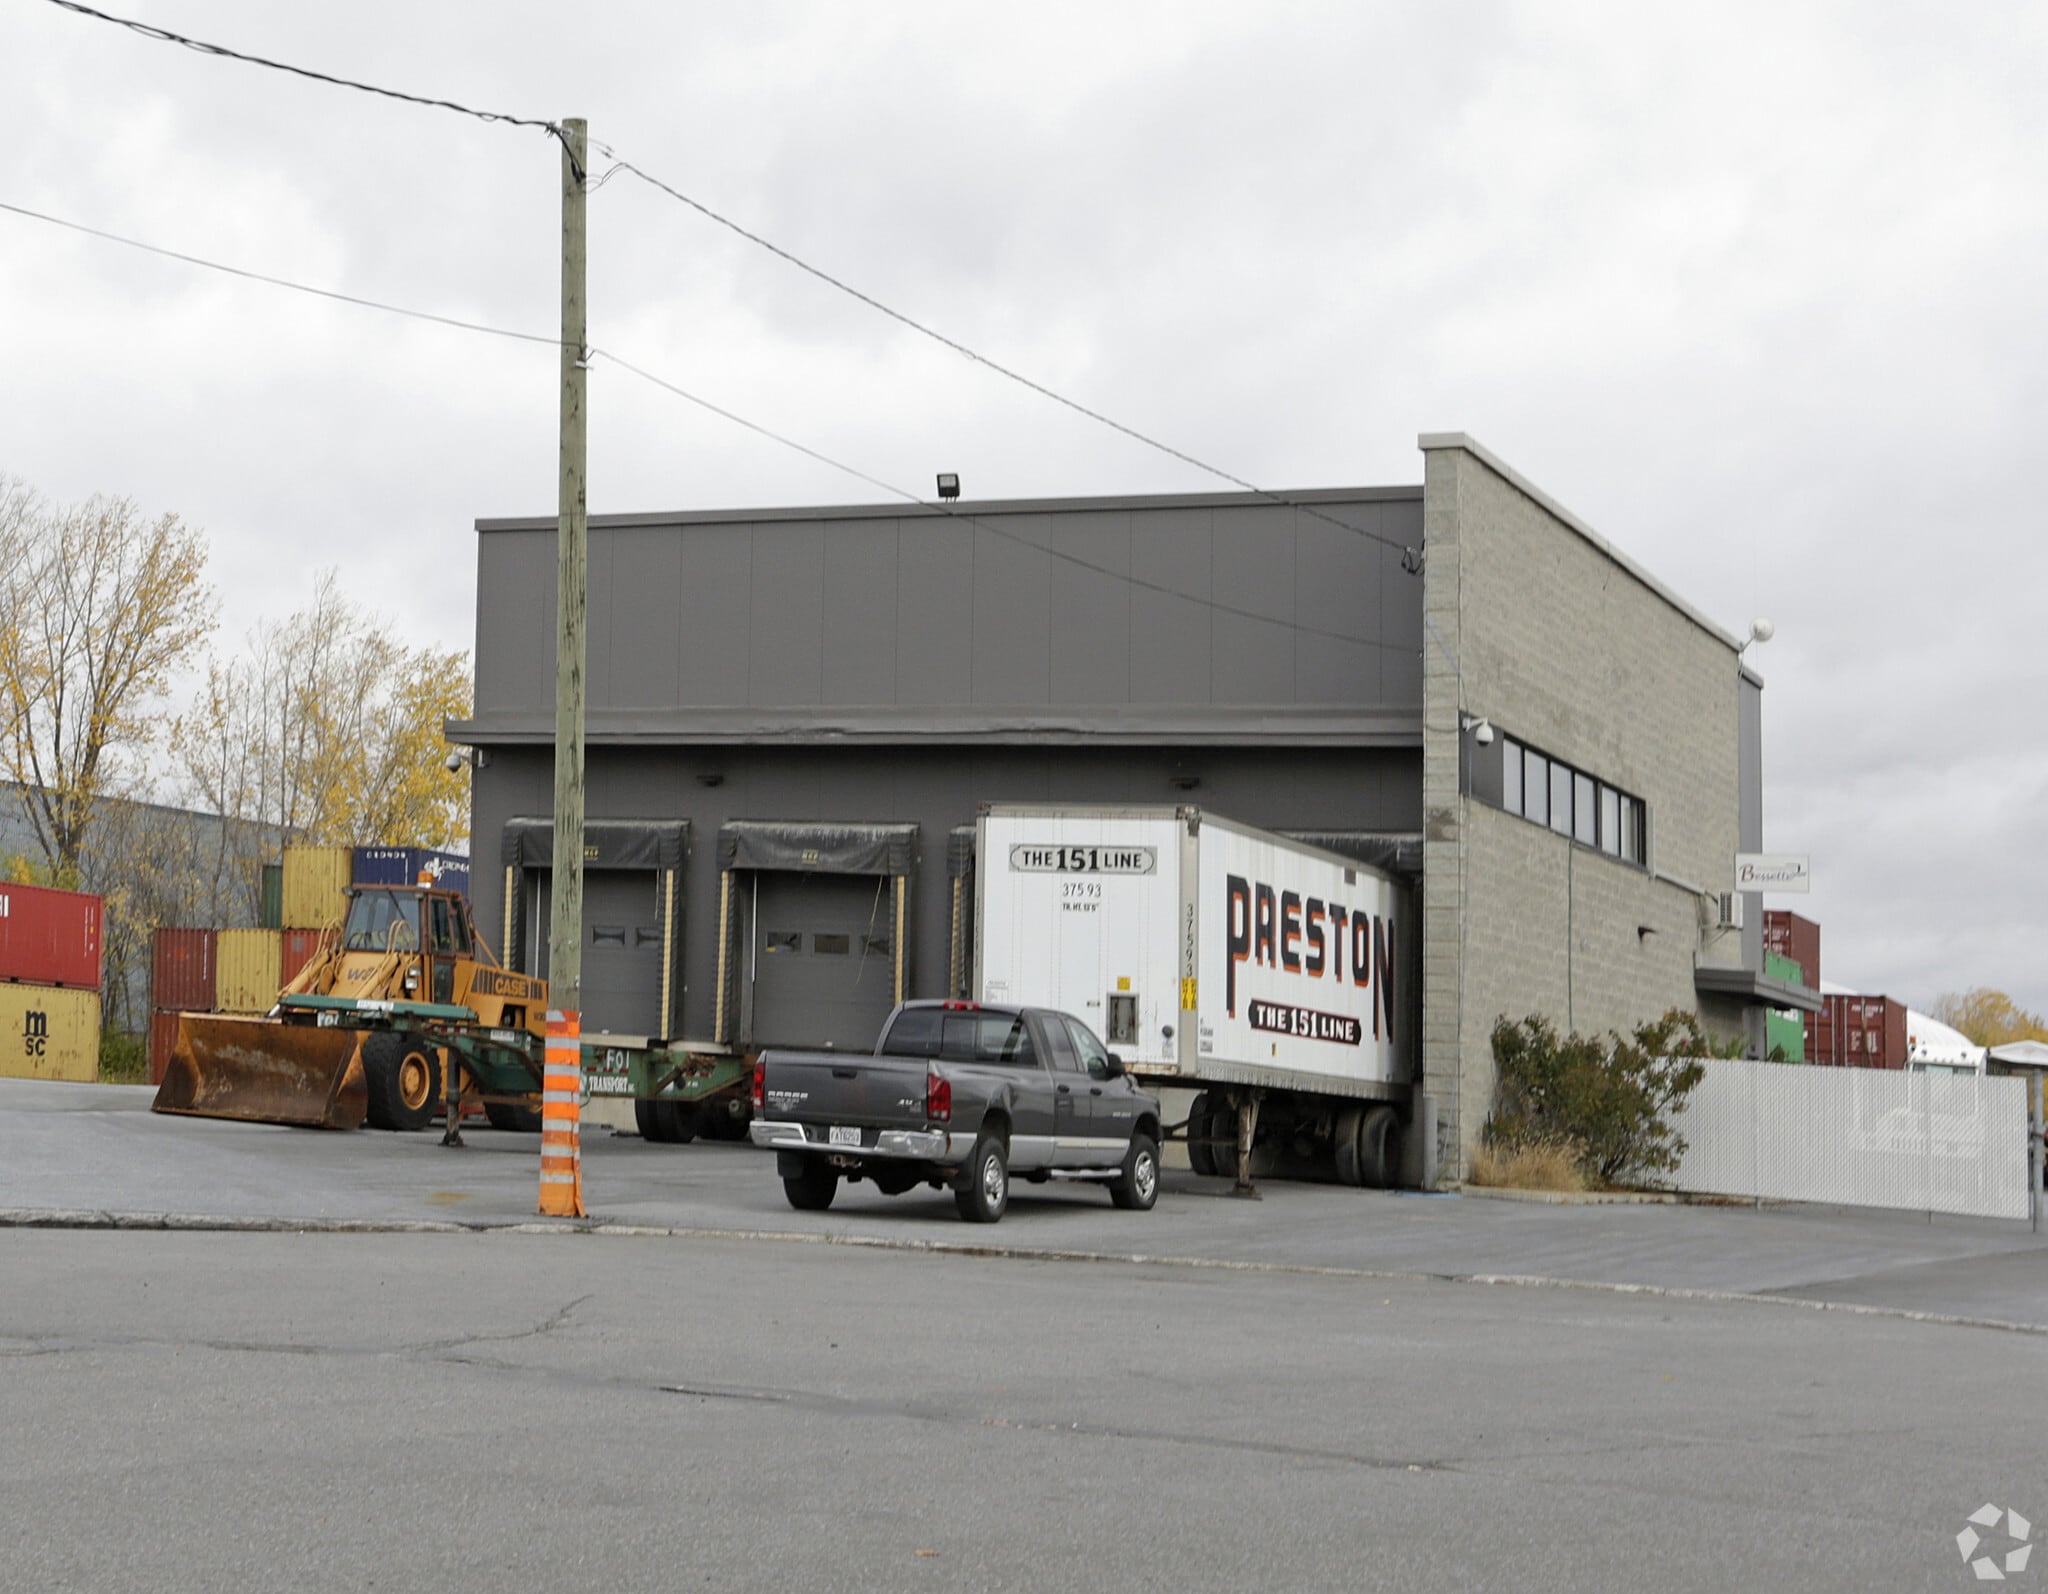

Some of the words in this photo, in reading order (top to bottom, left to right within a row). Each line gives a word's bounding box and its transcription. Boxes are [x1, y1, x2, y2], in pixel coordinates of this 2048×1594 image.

[1023, 851, 1053, 866] THE
[1056, 848, 1100, 871] 151
[1104, 853, 1142, 868] LINE
[1062, 882, 1102, 898] 37593
[1226, 873, 1394, 1044] PRESTON
[494, 977, 526, 996] CASE
[1257, 1005, 1287, 1030] THE
[1291, 1008, 1317, 1038] 151
[1321, 1016, 1354, 1041] LINE
[588, 1075, 628, 1093] TRANSPORT
